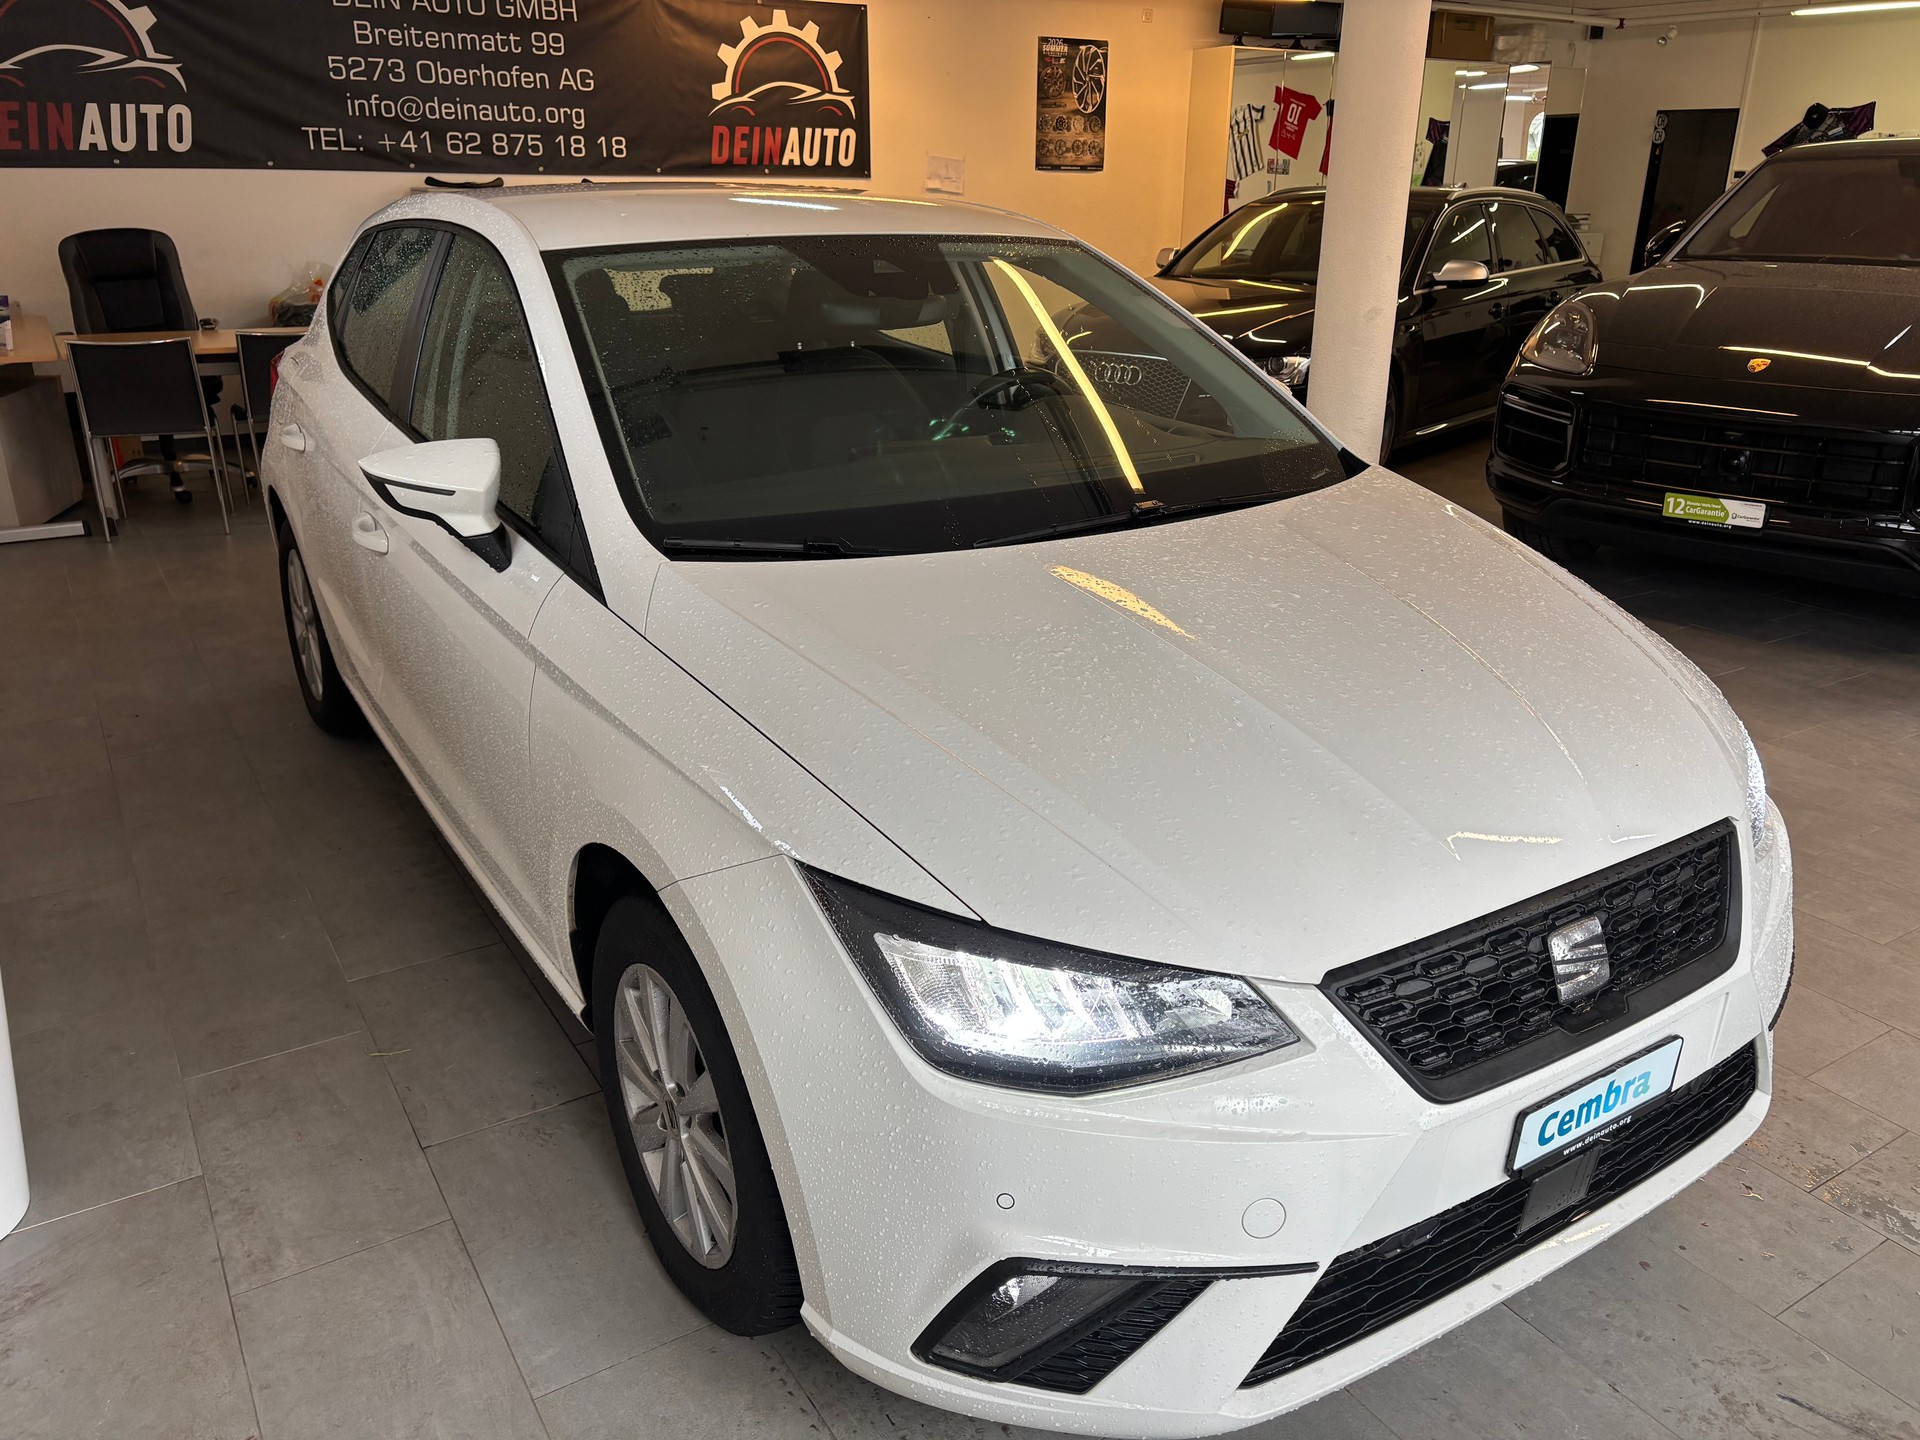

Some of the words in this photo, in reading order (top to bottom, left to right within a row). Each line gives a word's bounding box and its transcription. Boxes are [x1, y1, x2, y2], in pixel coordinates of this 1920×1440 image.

[496, 0, 578, 22] GMBH
[354, 20, 522, 54] Breitenmatt
[531, 31, 565, 56] 99
[327, 55, 406, 83] 5273
[416, 60, 549, 90] Oberhofen
[559, 67, 595, 92] AG
[0, 101, 193, 153] EINAUTO
[346, 92, 586, 130] info@deinauto.org
[301, 126, 364, 152] TEL:
[378, 130, 432, 154] +41
[446, 131, 482, 155] 62
[492, 133, 543, 156] 875
[554, 134, 586, 158] 18
[597, 136, 627, 158] 18
[711, 125, 857, 167] DEINAUTO
[1667, 497, 1685, 515] 12
[1538, 1070, 1652, 1147] Cembra
[1563, 1115, 1633, 1156] www.deinauto.org
